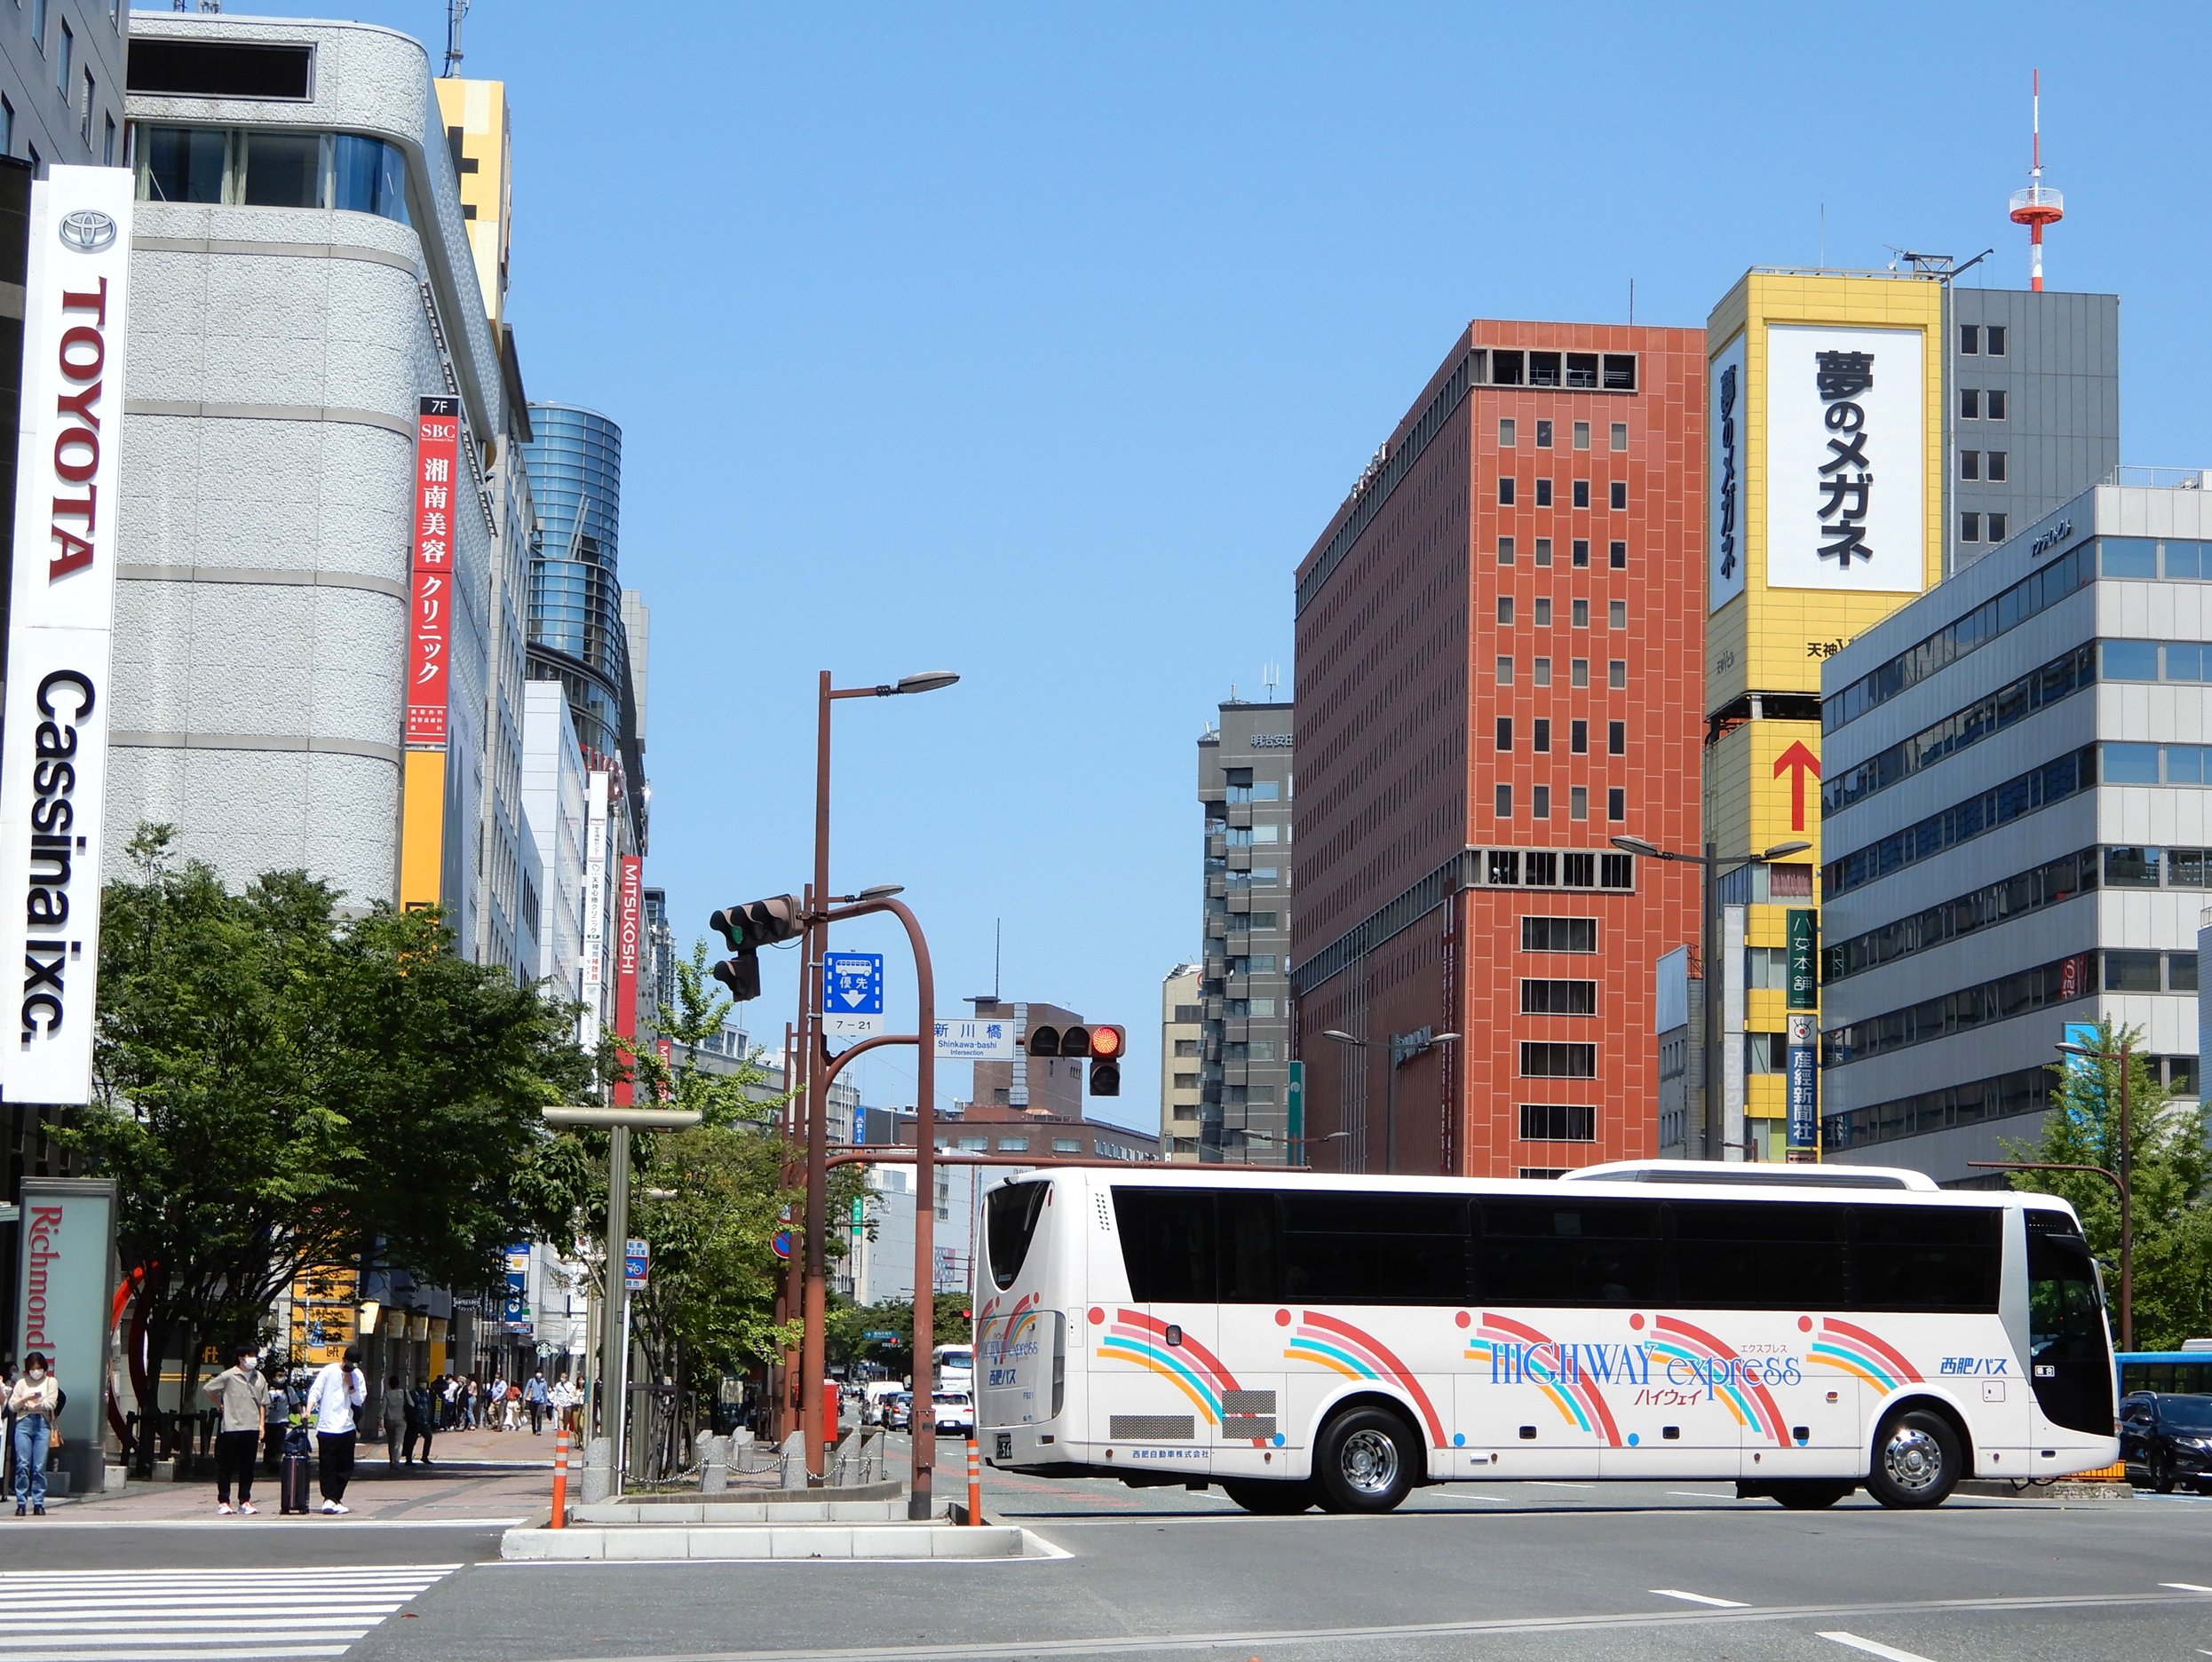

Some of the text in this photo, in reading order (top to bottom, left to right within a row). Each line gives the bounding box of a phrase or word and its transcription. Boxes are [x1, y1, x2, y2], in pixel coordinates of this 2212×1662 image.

[432, 400, 448, 414] 7F
[49, 276, 107, 582] TOYOTA
[421, 423, 456, 439] SBC
[1815, 351, 1875, 566] 夢のメガネ
[1720, 364, 1736, 580] 夢のメガネ
[417, 458, 449, 685] 湘南美容クリニック
[27, 669, 96, 924] Cassina
[622, 864, 638, 975] MITSUKOSHI
[839, 976, 868, 990] 優先
[934, 1023, 1003, 1040] 新川橋
[938, 1040, 997, 1049] Shinkawa-bashi
[26, 1205, 63, 1350] Richmond
[326, 1347, 339, 1357] Loft
[1740, 1344, 1788, 1354] エクスプレス
[1489, 1341, 1802, 1401] HIGHWAY express
[1939, 1357, 2008, 1375] 西肥バス
[989, 1368, 1017, 1387] 西肥バス
[1633, 1389, 1702, 1406] ハイウェイ
[1132, 1450, 1209, 1459] 西肥自動車株式会社
